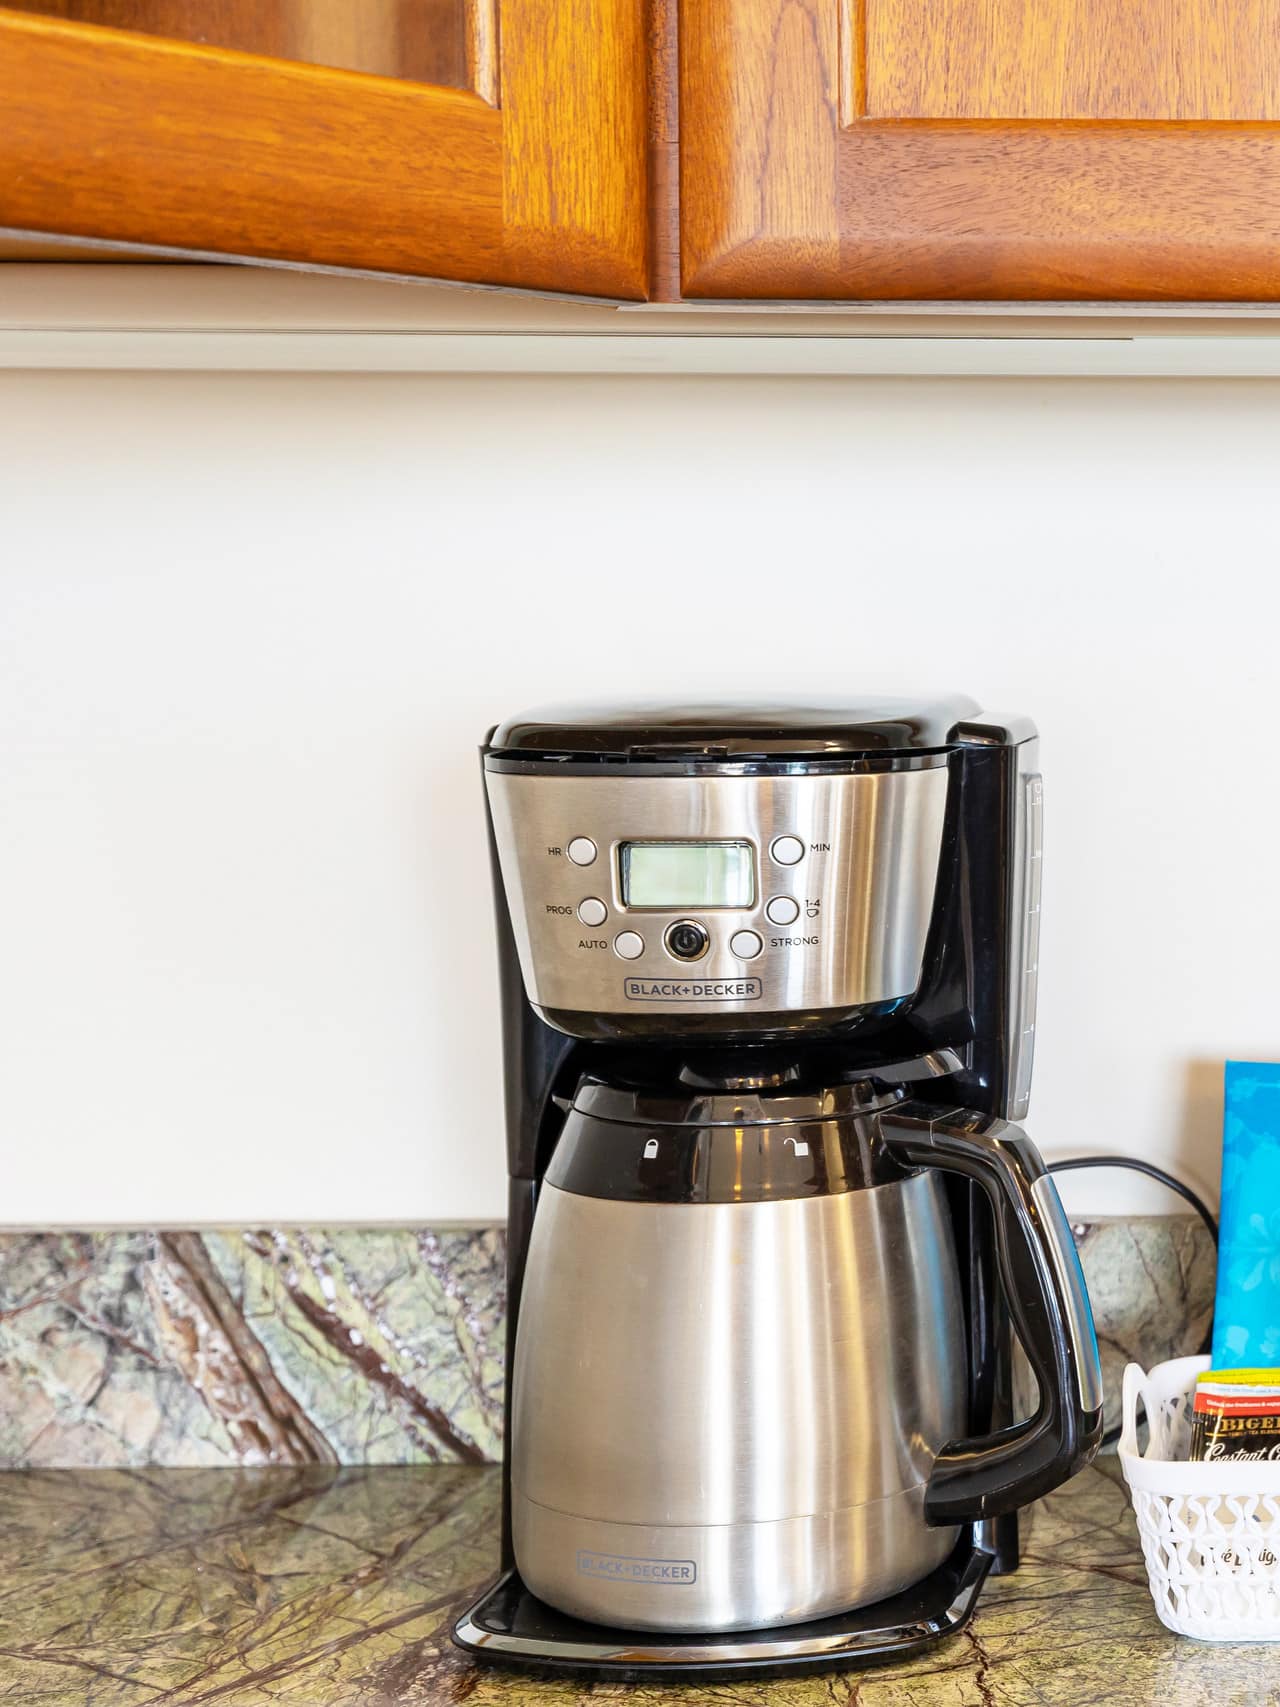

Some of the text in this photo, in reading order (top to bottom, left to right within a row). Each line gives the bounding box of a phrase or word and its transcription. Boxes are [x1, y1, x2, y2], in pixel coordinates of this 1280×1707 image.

[548, 847, 562, 856] HR
[810, 843, 831, 852] MIN
[805, 899, 821, 908] 1-4
[546, 905, 572, 916] PROG
[578, 940, 608, 949] AUTO
[770, 936, 819, 947] STRONG
[630, 983, 755, 996] BLACK+DECKER
